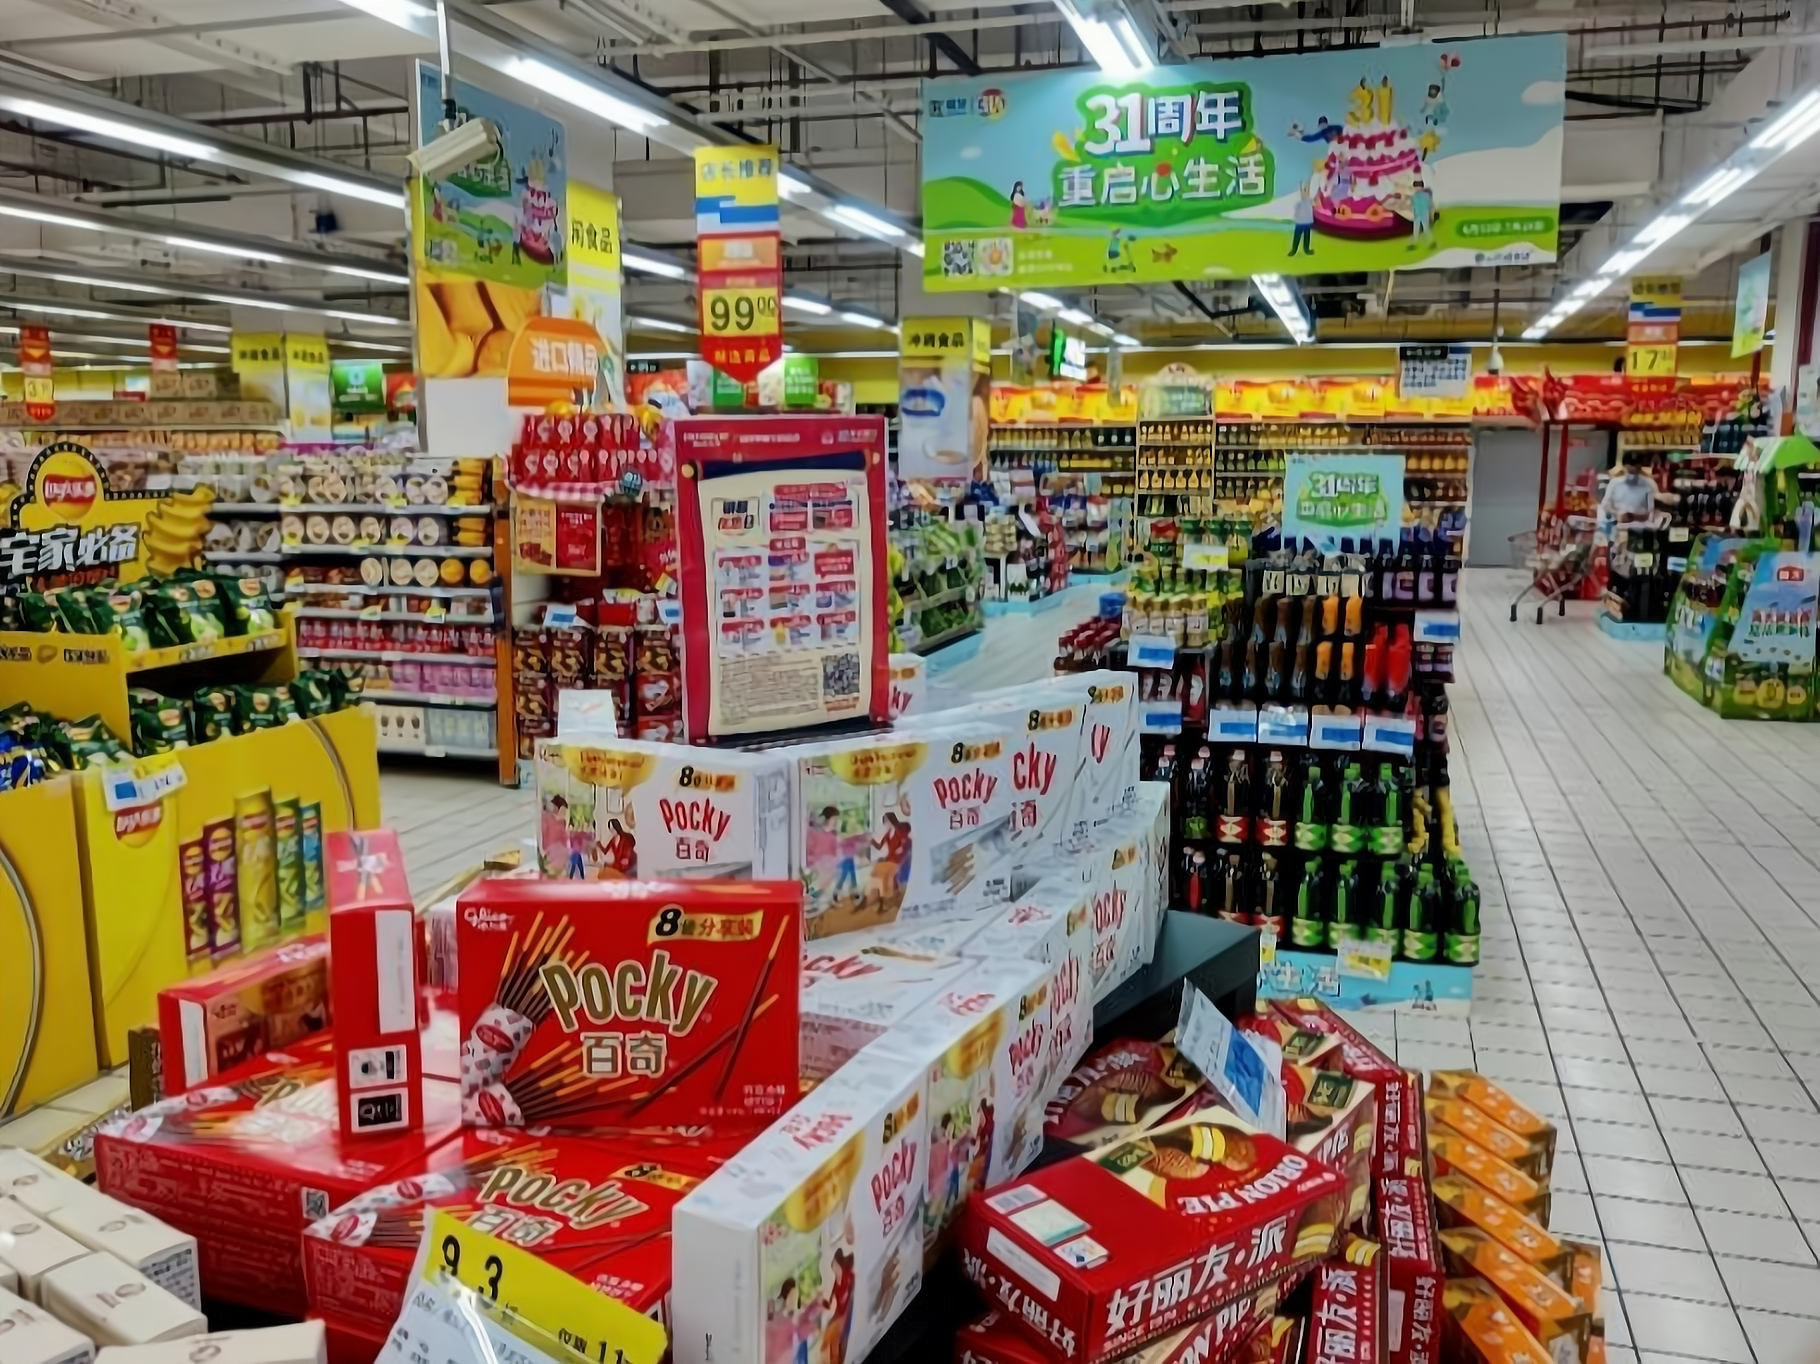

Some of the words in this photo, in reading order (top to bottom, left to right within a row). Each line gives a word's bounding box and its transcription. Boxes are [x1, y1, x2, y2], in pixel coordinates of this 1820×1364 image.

[1084, 91, 1242, 155] 31周年
[1058, 154, 1266, 207] 重启心生活
[710, 296, 755, 331] 99
[934, 768, 998, 810] Pocky
[659, 798, 732, 842] Pocky
[539, 949, 718, 1037] Pocky
[580, 1031, 668, 1078] 百奇
[476, 1163, 649, 1230] Pocky
[871, 1138, 918, 1214] Pocky
[1234, 1153, 1308, 1205] ORION
[1176, 1191, 1243, 1215] PIE
[1105, 1213, 1294, 1337] 好丽友·派
